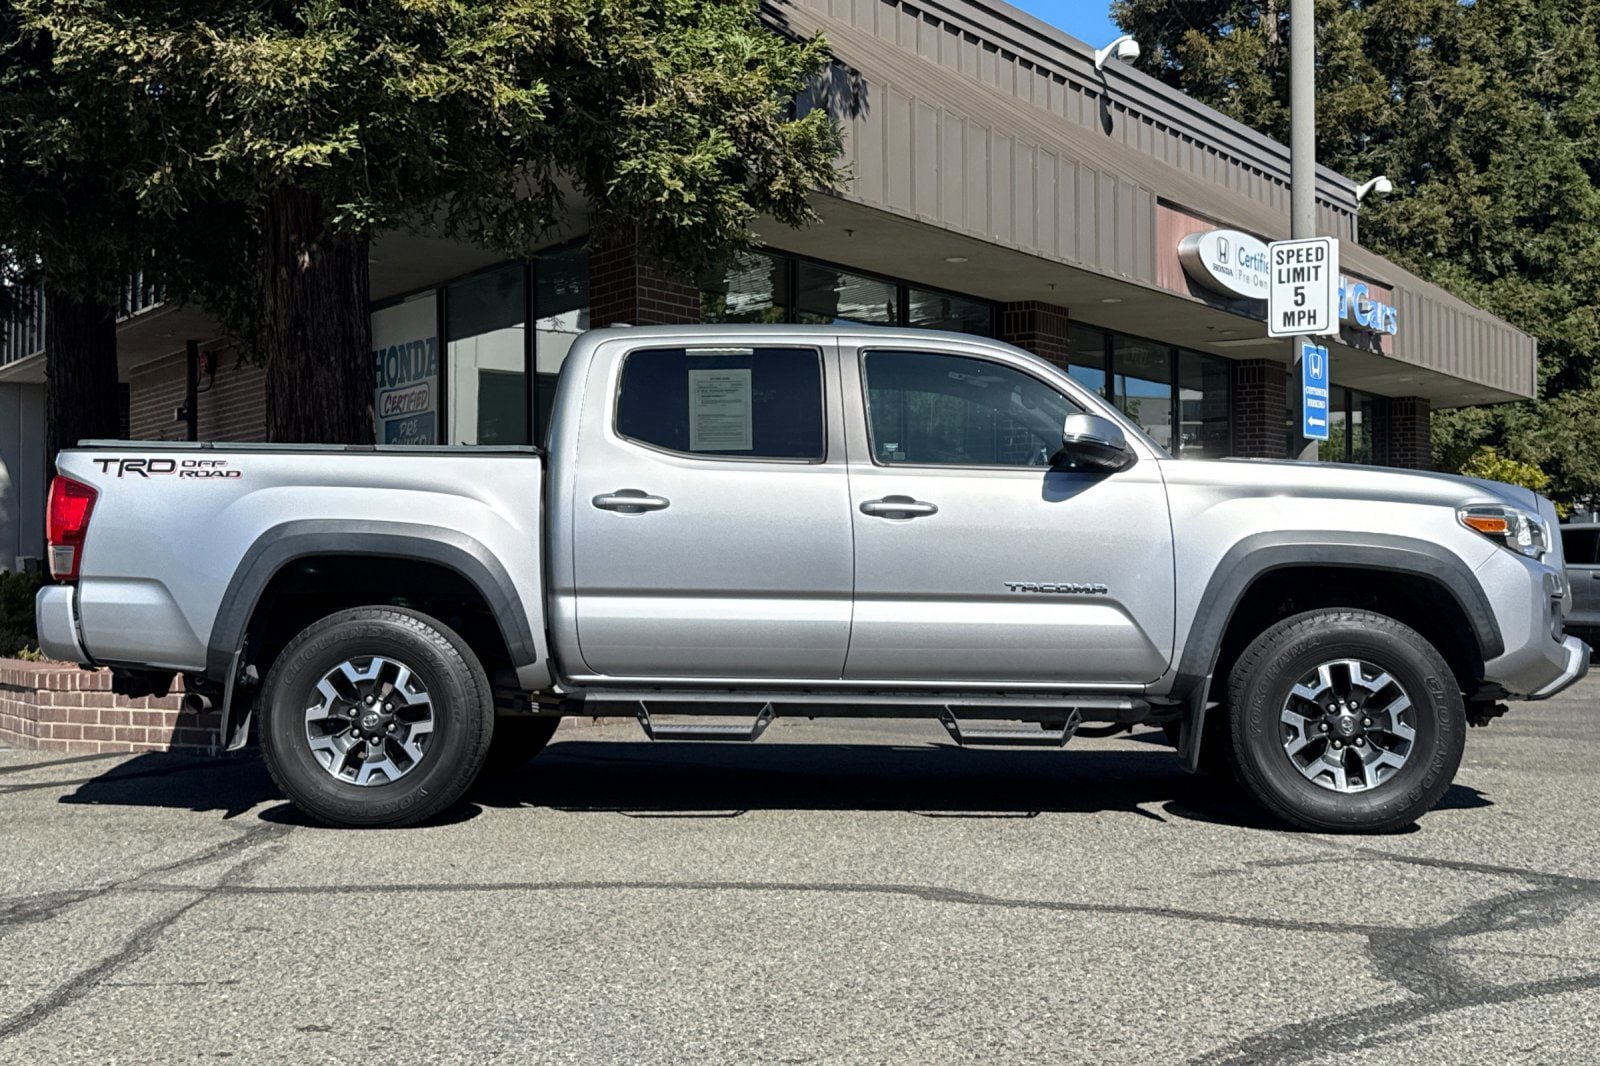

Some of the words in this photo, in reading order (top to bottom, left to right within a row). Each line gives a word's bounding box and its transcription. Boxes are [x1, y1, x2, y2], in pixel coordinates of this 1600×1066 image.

[1238, 246, 1269, 275] Certifie
[1276, 246, 1324, 265] SPEED
[1212, 262, 1234, 277] HONDA
[1278, 265, 1322, 284] LIMIT
[1253, 274, 1268, 288] Own
[1293, 286, 1305, 307] 5
[1283, 310, 1317, 327] MPH
[1353, 282, 1398, 336] Cars
[373, 336, 437, 389] HONDA
[384, 389, 428, 414] CERTIFIED
[400, 419, 418, 437] PRE
[93, 458, 178, 479] TRD
[181, 459, 228, 468] OFF
[179, 470, 244, 479] ROAD
[1003, 581, 1108, 594] TACOMA
